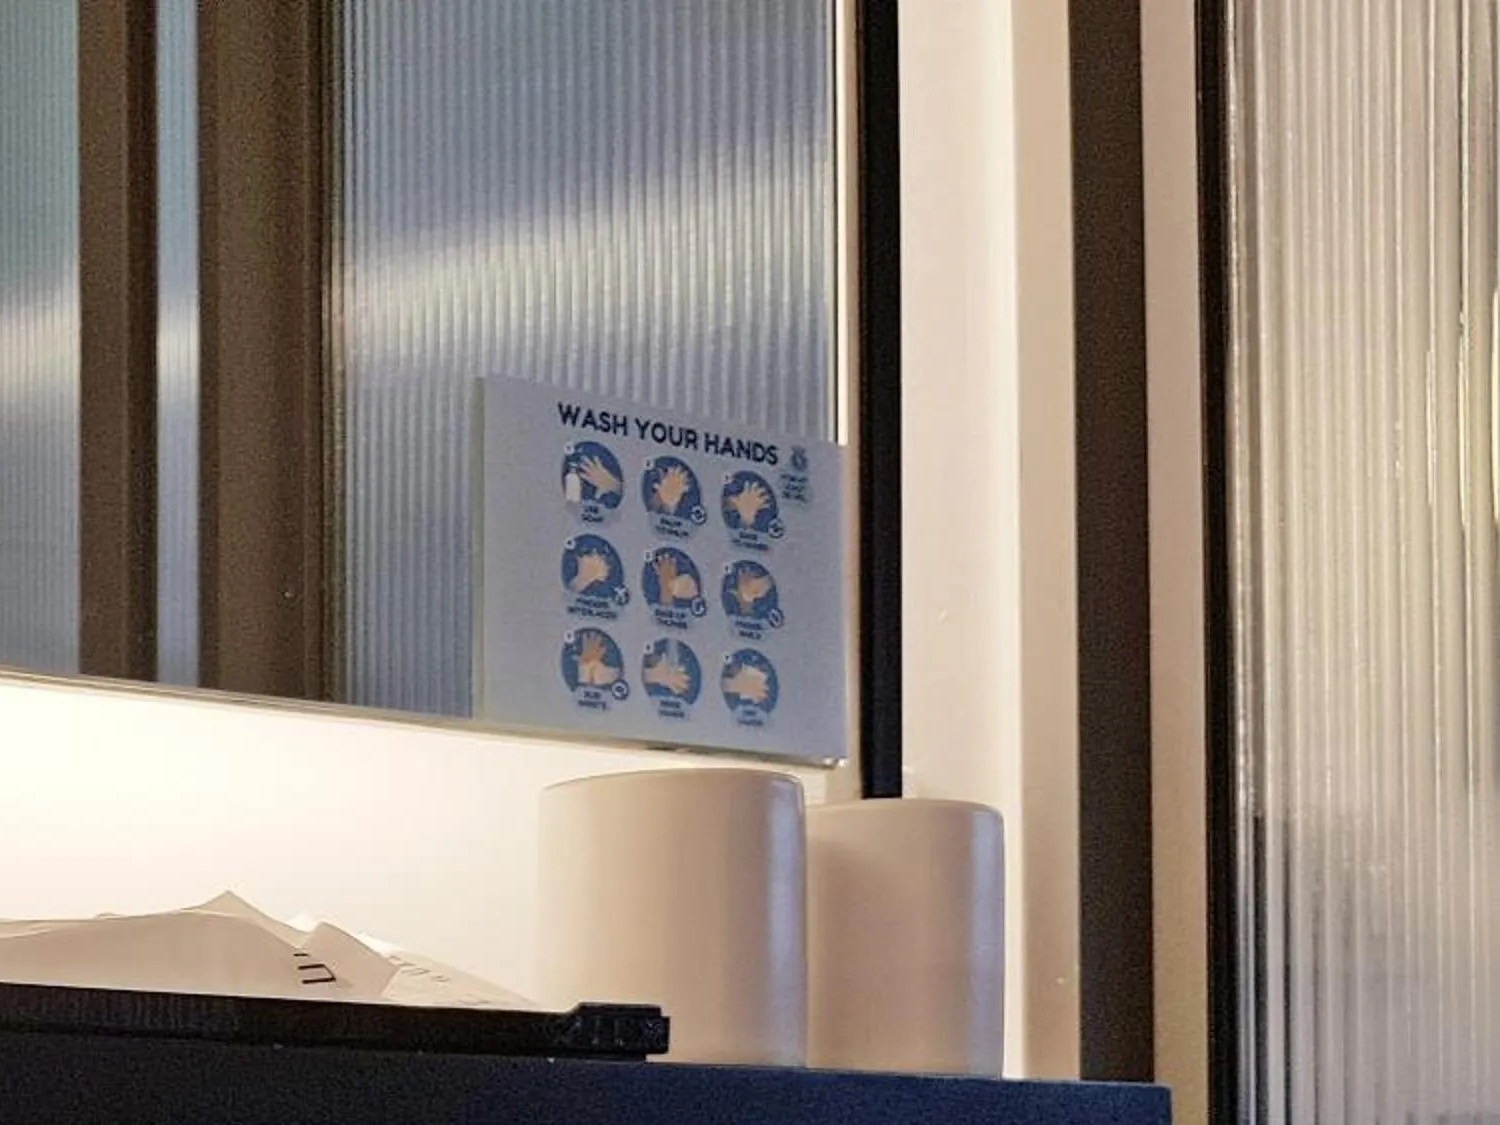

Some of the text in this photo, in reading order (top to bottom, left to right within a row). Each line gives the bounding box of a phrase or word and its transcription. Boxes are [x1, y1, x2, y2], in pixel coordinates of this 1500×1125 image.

[558, 402, 779, 466] WASH YOUR HANDS
